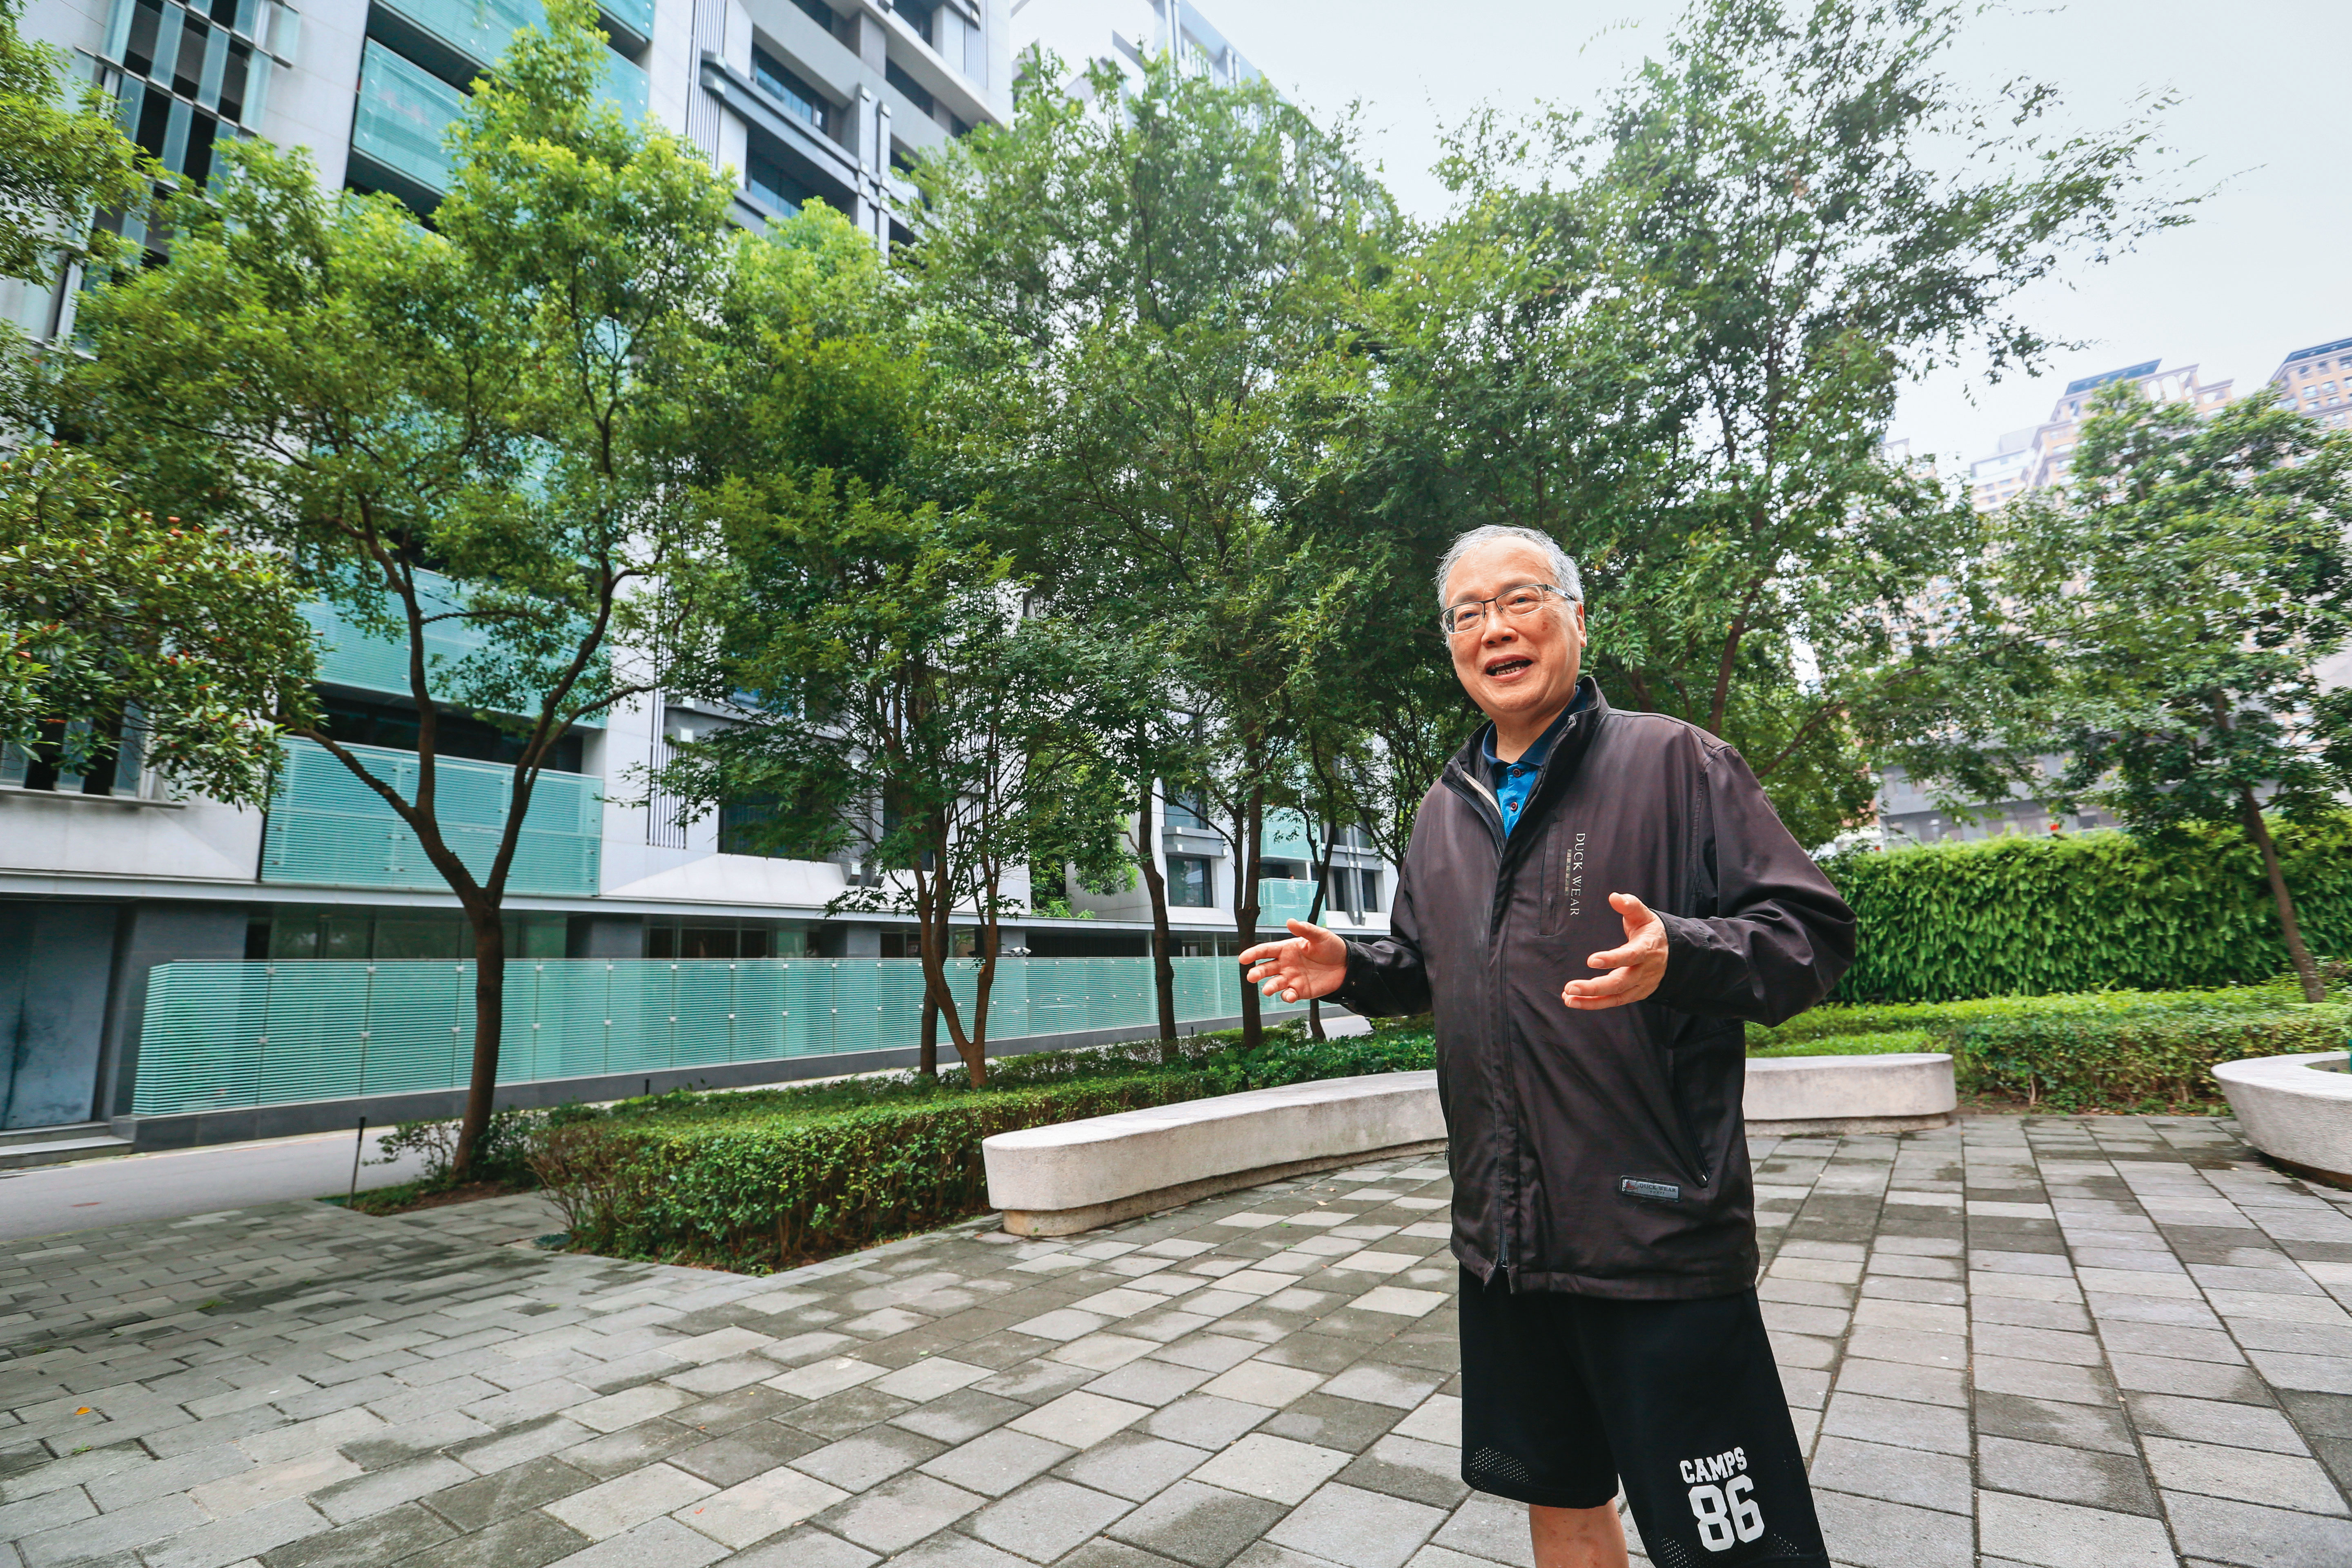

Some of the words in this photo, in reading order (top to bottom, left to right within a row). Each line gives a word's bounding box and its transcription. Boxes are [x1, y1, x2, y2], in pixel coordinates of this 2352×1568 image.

[1573, 833, 1586, 871] DUCK
[1570, 875, 1582, 915] WEAR
[1679, 1446, 1747, 1483] CAMPS
[1688, 1474, 1765, 1552] 86
